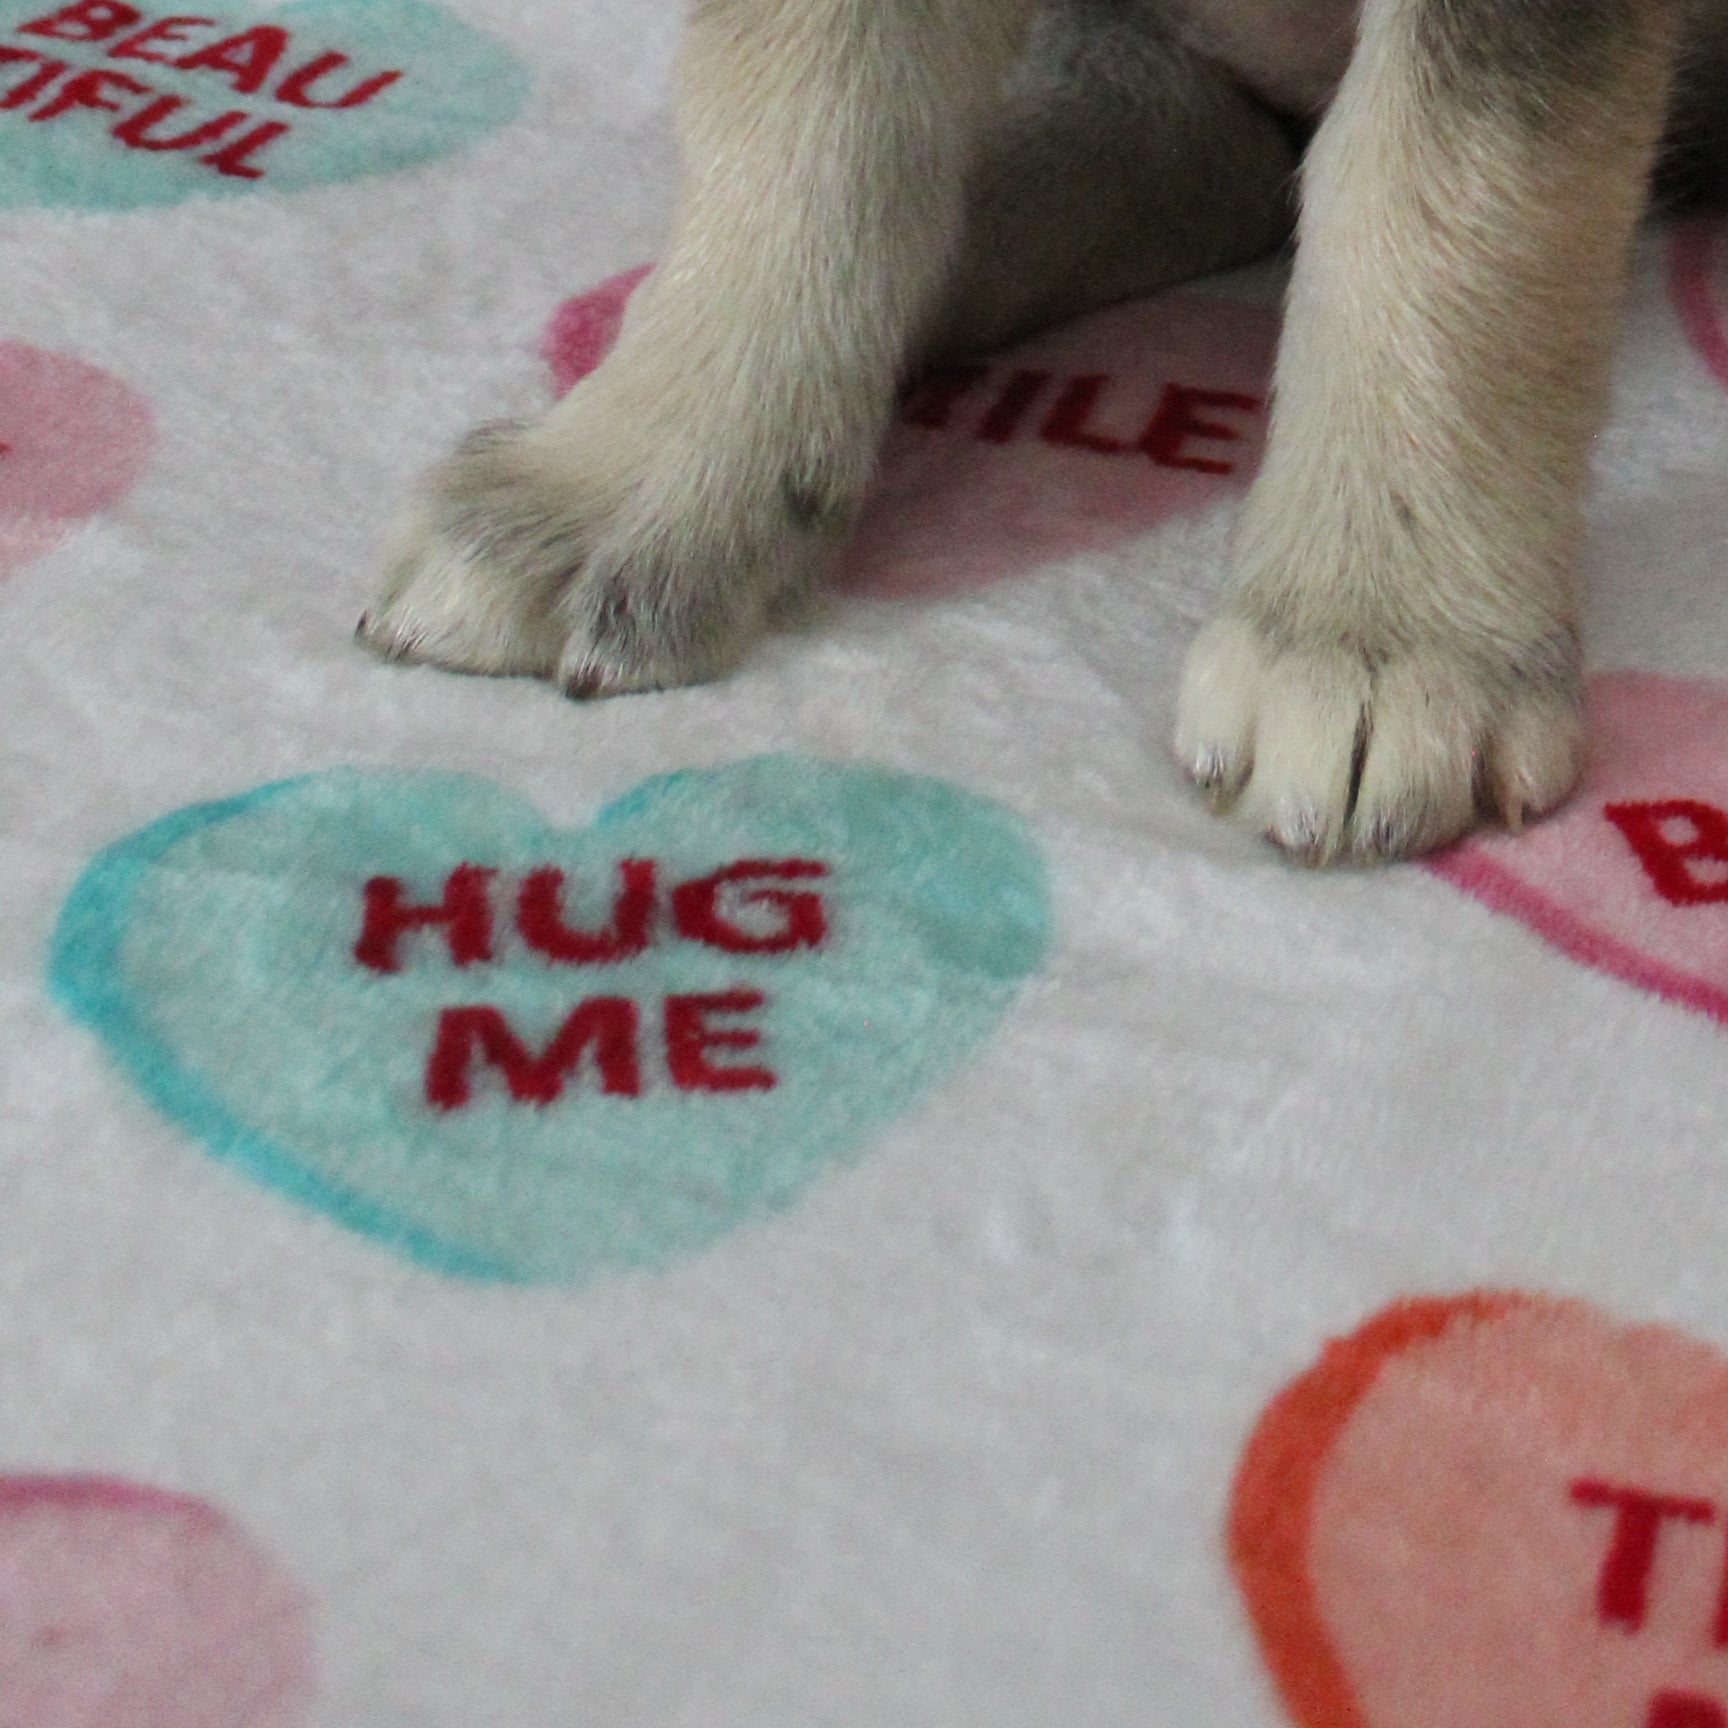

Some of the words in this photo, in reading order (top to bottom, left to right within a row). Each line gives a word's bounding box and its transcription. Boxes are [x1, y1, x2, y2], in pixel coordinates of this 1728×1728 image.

[900, 364, 1264, 476] ILE
[352, 856, 832, 975] HUG
[423, 984, 778, 1110] ME
